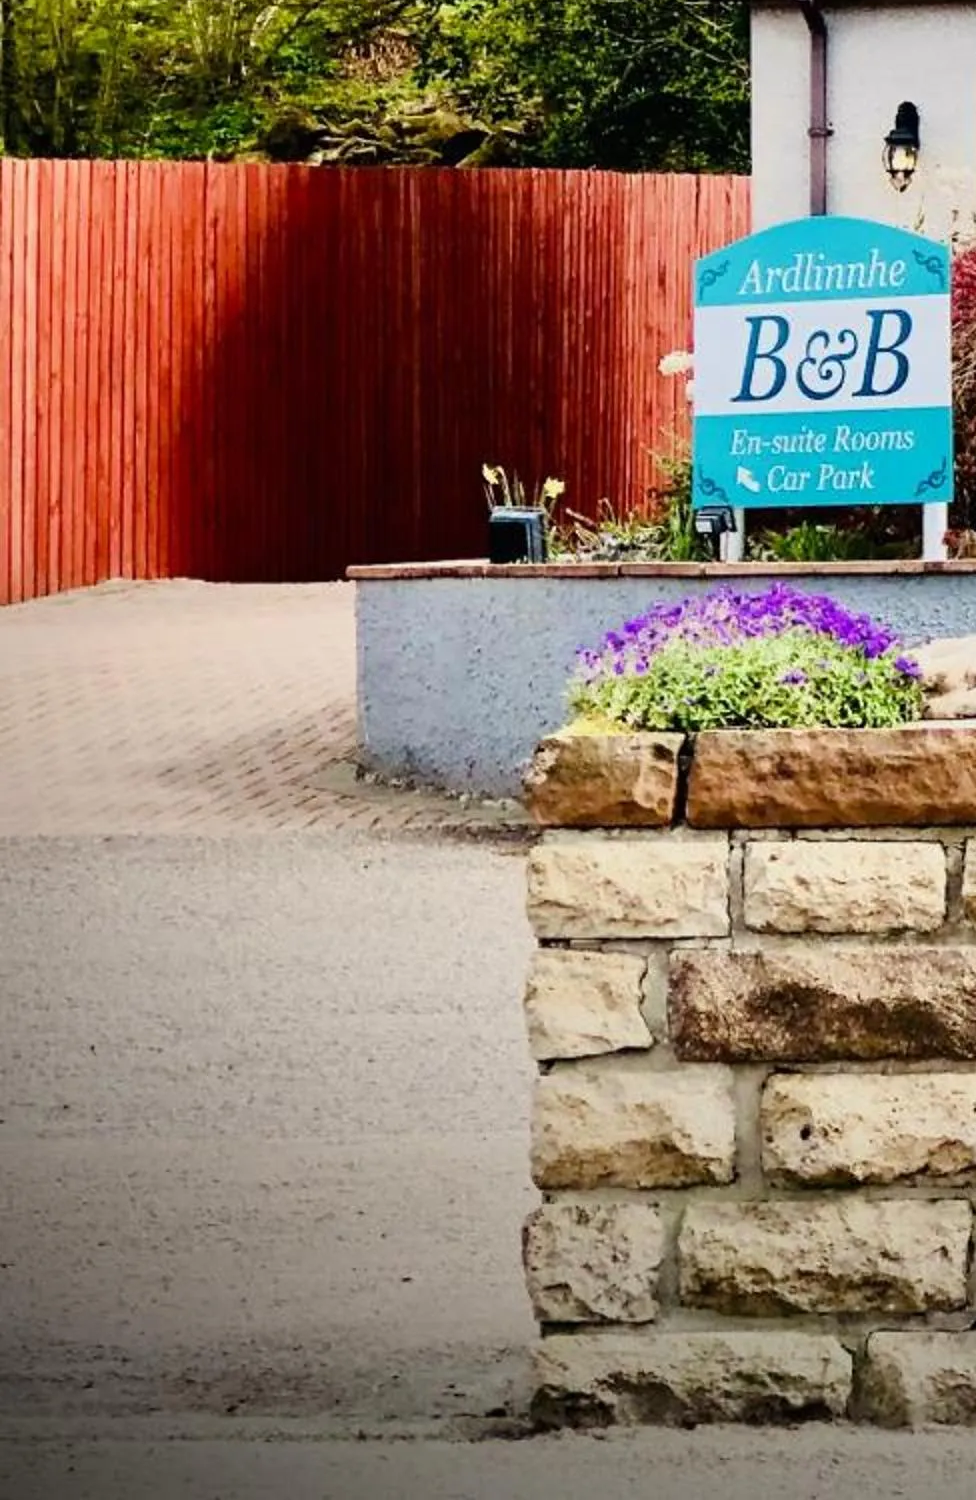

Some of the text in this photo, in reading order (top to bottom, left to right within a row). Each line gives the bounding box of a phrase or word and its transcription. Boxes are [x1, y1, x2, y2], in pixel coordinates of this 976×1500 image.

[738, 249, 907, 295] Ardlinnhe
[729, 309, 913, 403] B&B
[730, 424, 915, 455] En-suite Rooms
[767, 462, 875, 493] Car Park
